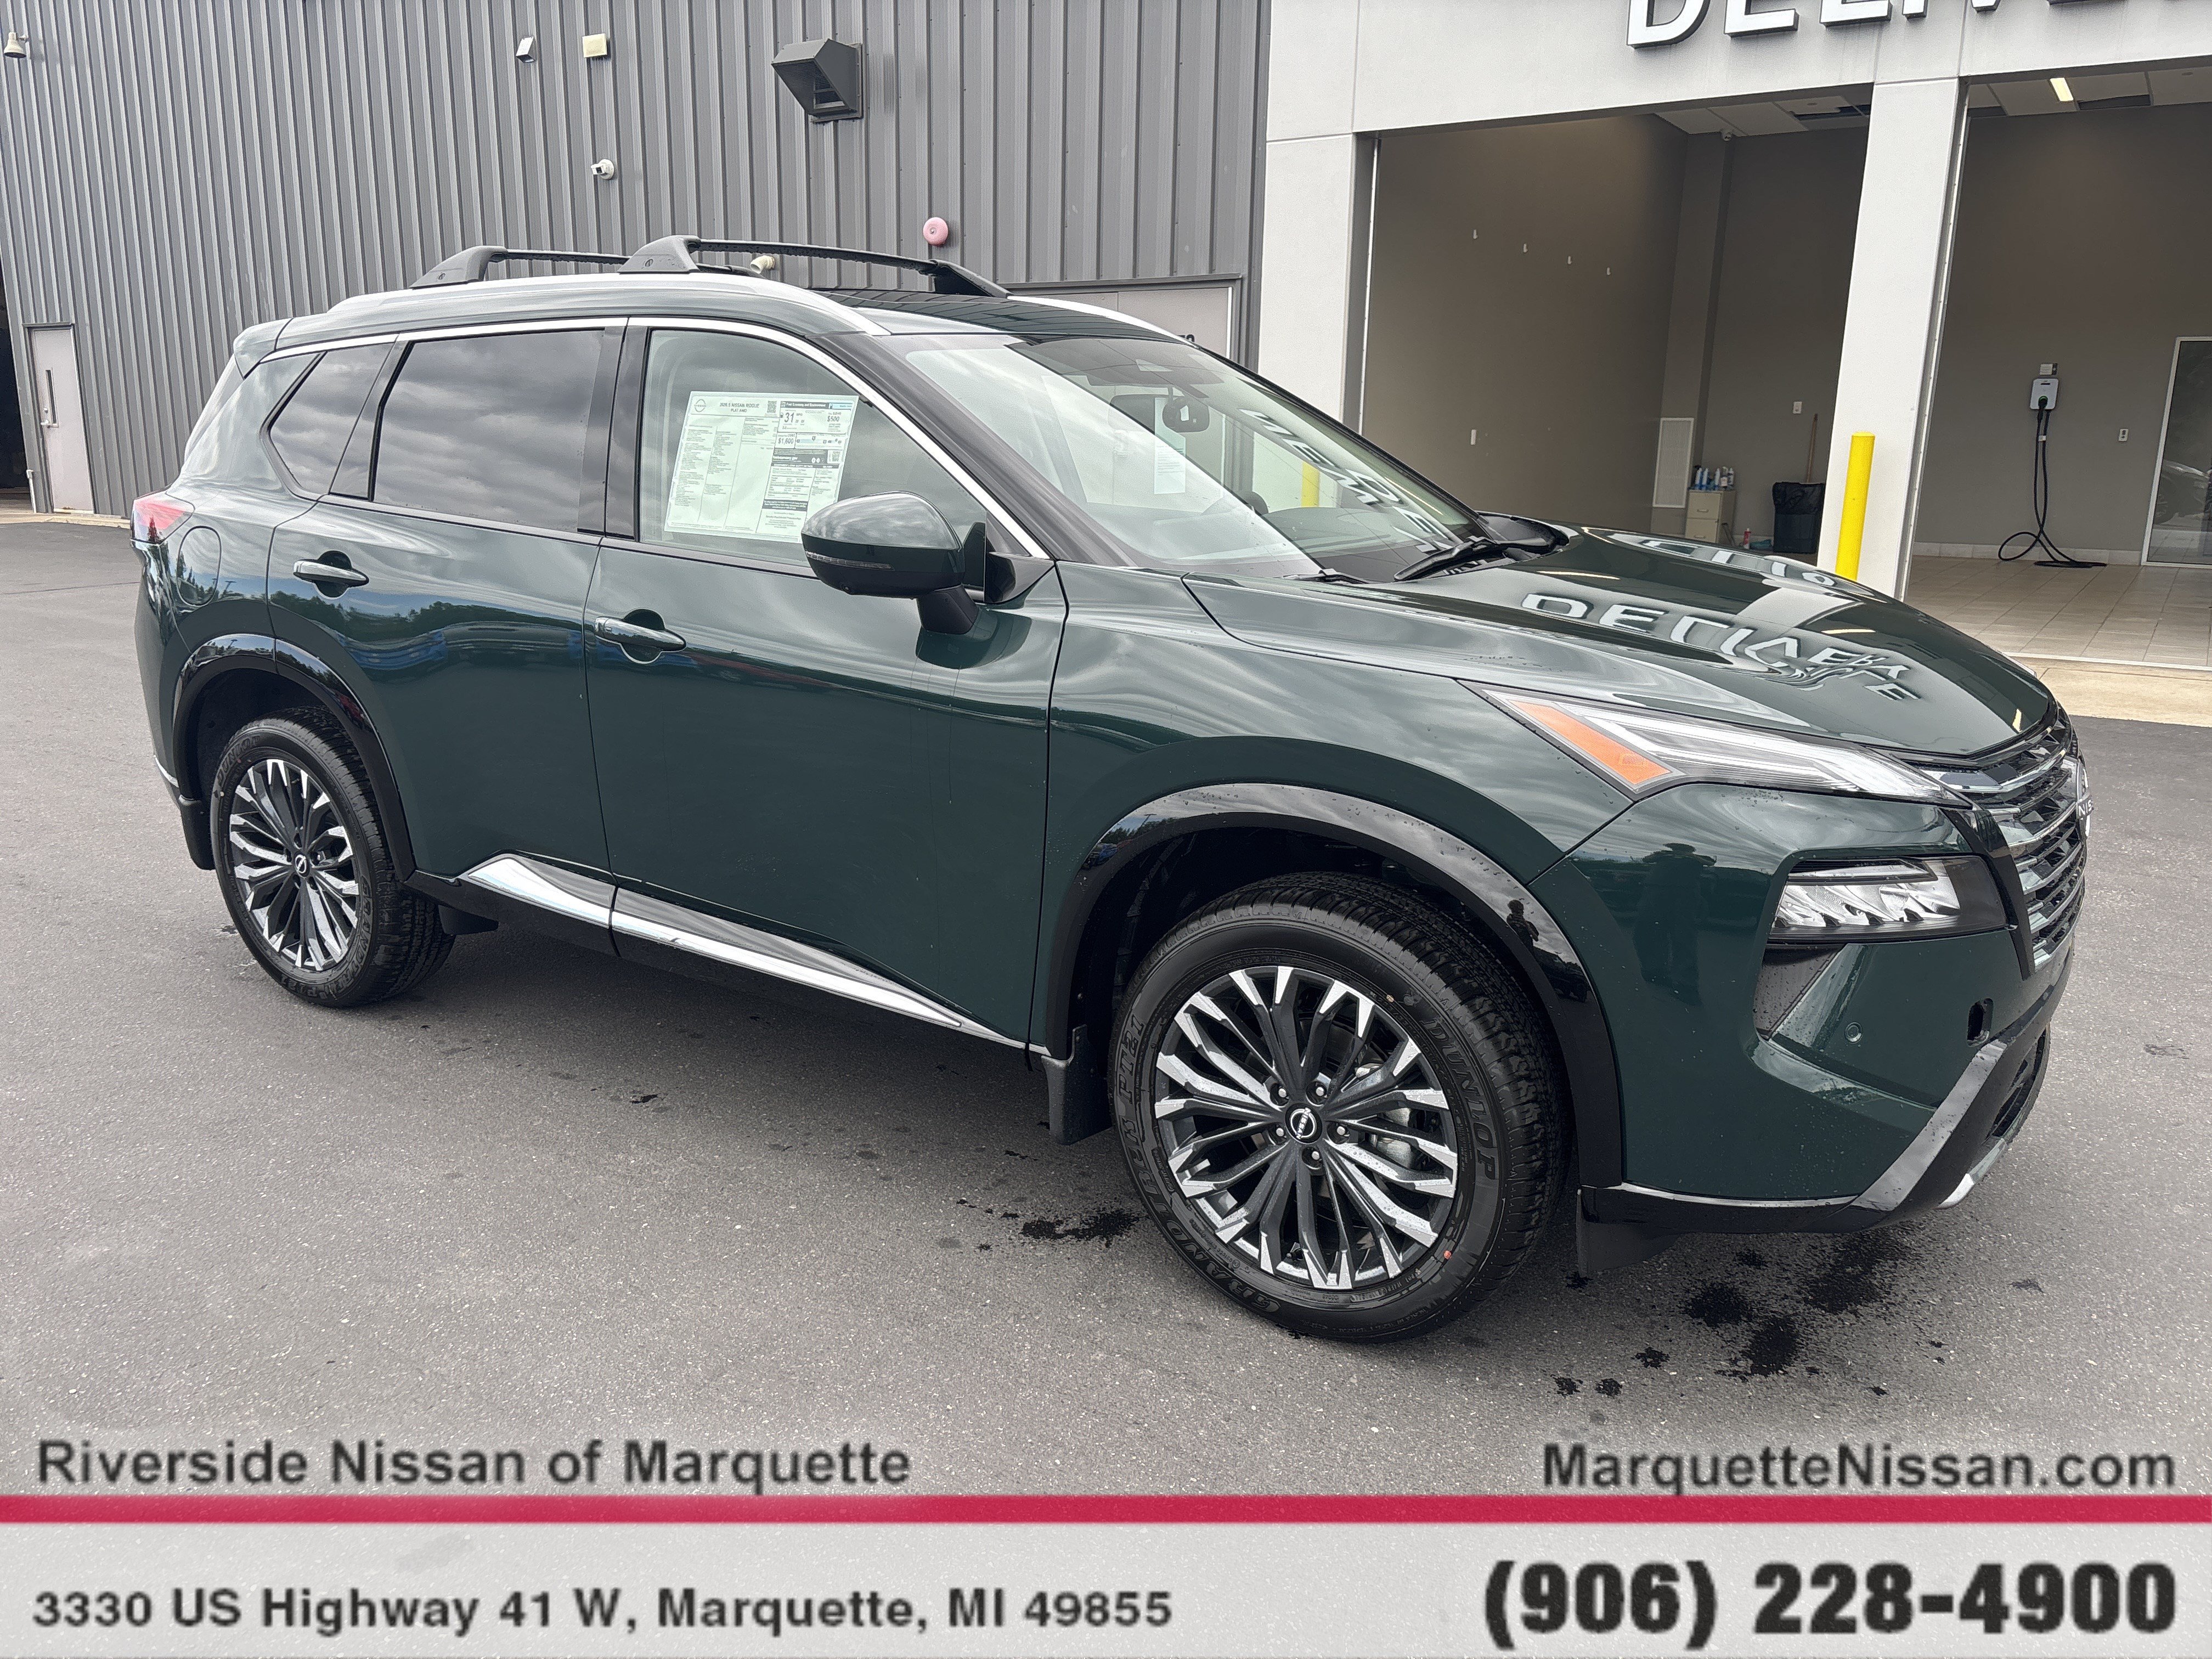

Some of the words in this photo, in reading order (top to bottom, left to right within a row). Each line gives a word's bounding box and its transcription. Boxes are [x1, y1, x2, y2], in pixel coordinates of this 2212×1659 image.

[784, 412, 794, 423] 31
[1119, 1014, 1145, 1105] PT21
[1296, 1107, 1311, 1140] NISSAN
[1420, 1018, 1496, 1180] DUNLOP
